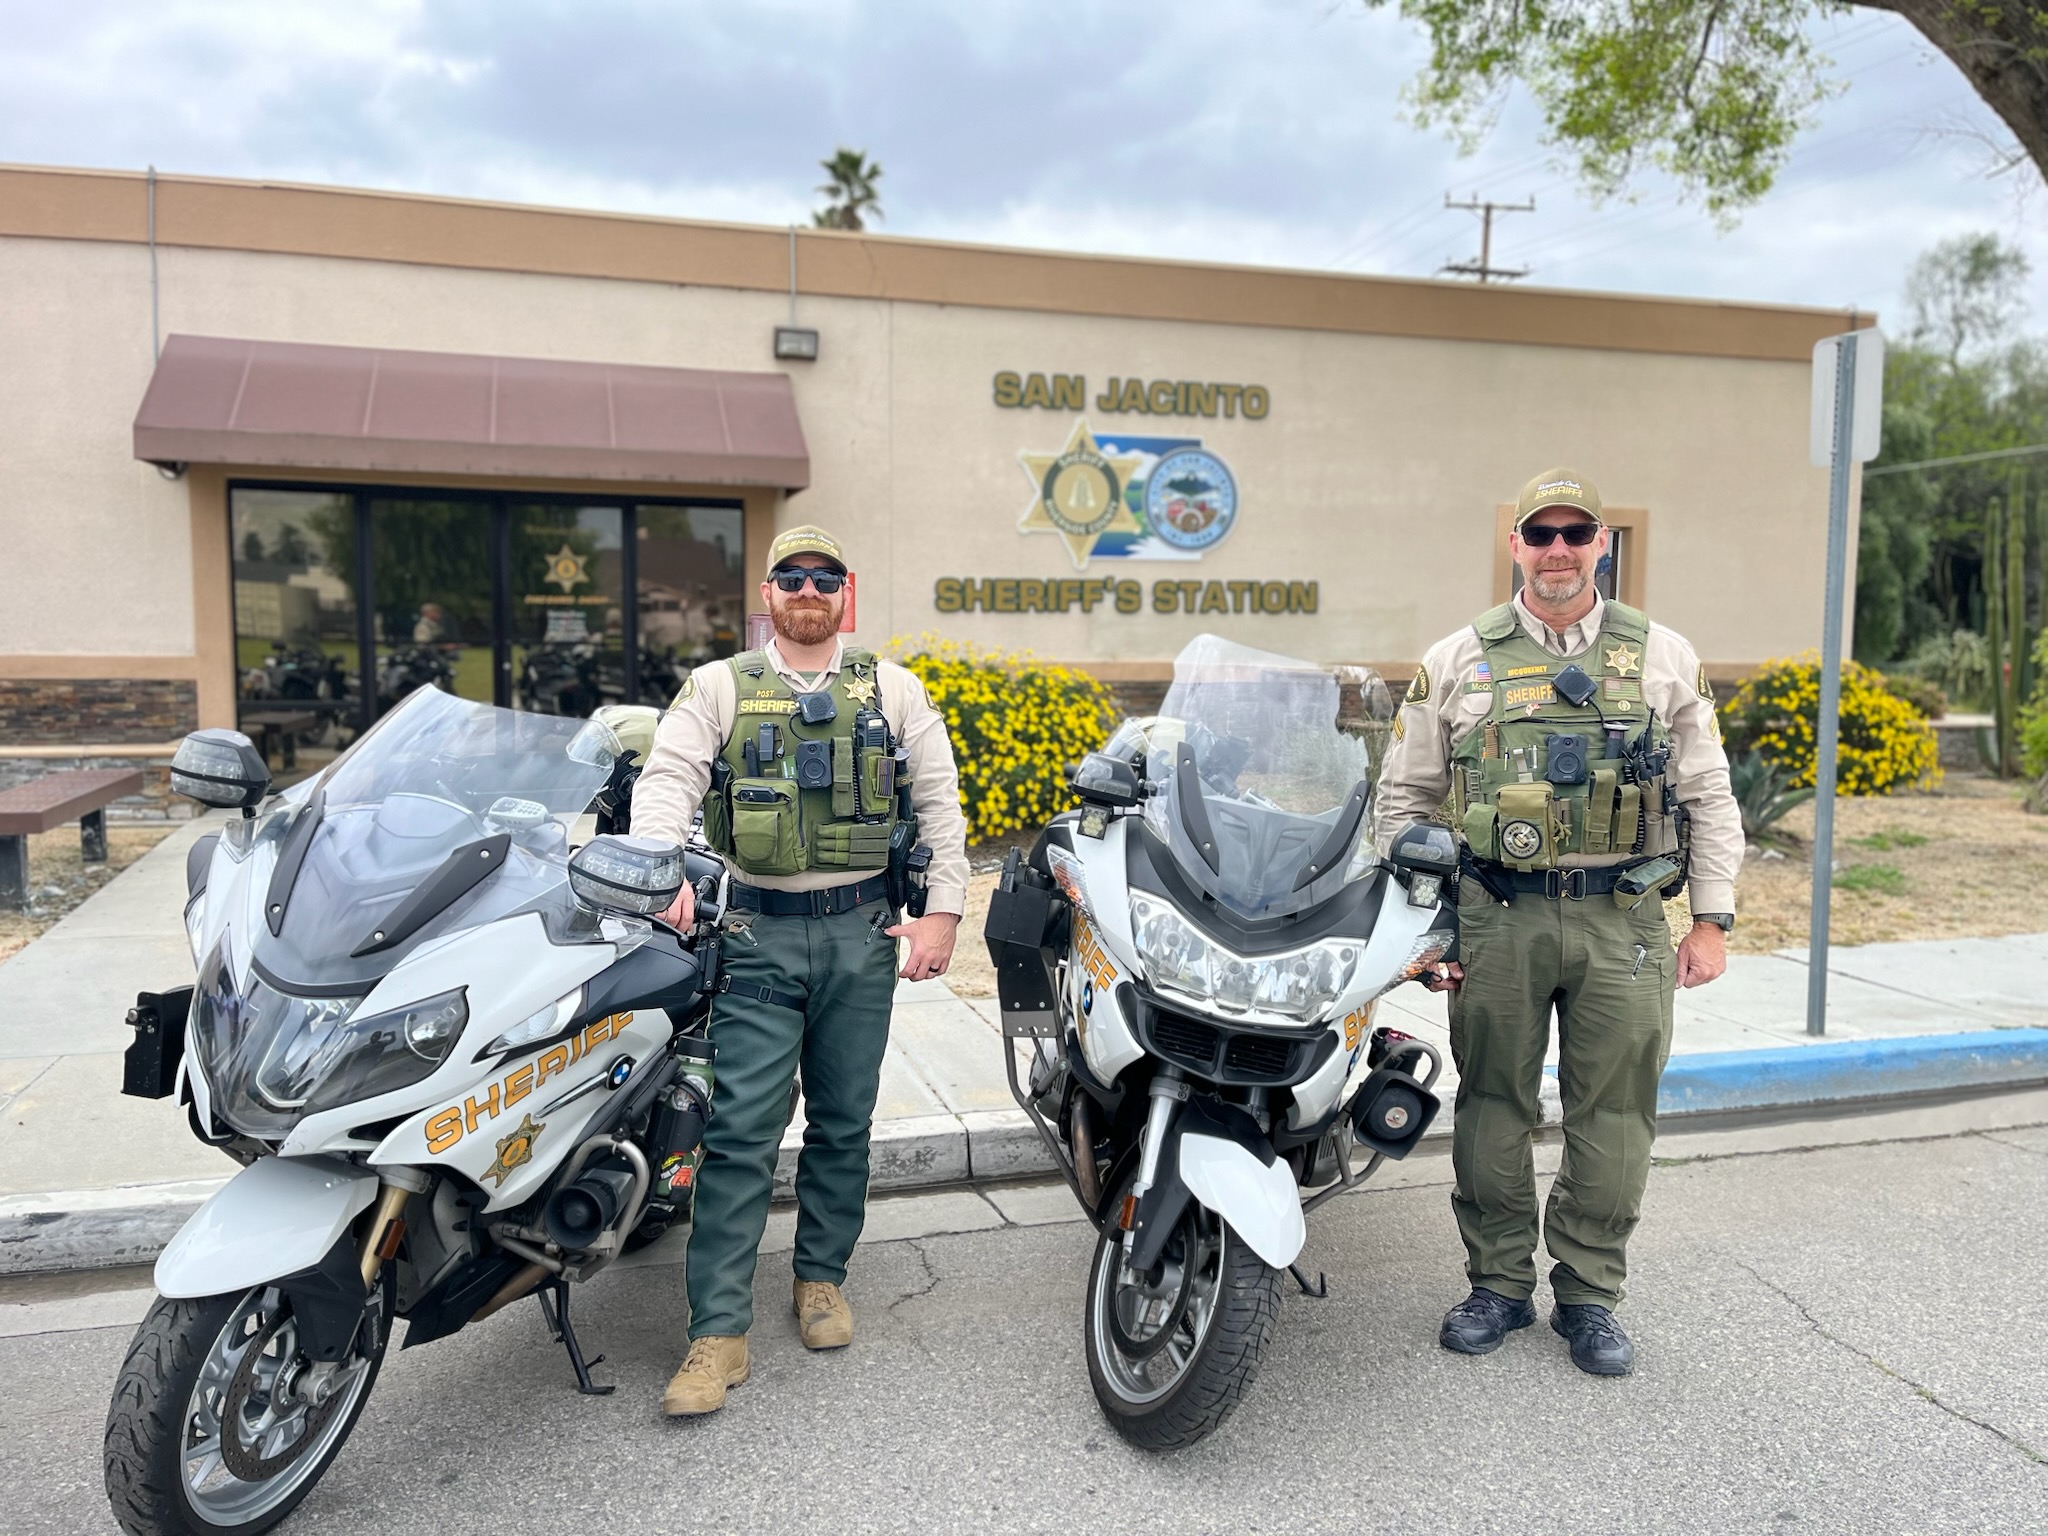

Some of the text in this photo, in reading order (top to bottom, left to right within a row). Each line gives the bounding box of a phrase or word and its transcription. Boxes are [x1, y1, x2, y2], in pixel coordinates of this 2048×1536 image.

[994, 371, 1270, 419] SAN JACINTO
[1539, 486, 1579, 498] SHERIFF
[935, 576, 1319, 615] SHERIFF'S STATION
[756, 690, 774, 698] POST
[1419, 672, 1427, 697] COUNTY
[1506, 684, 1553, 704] SHERIFF
[740, 700, 796, 713] SHERIFF
[425, 1011, 633, 1155] SHERIFF
